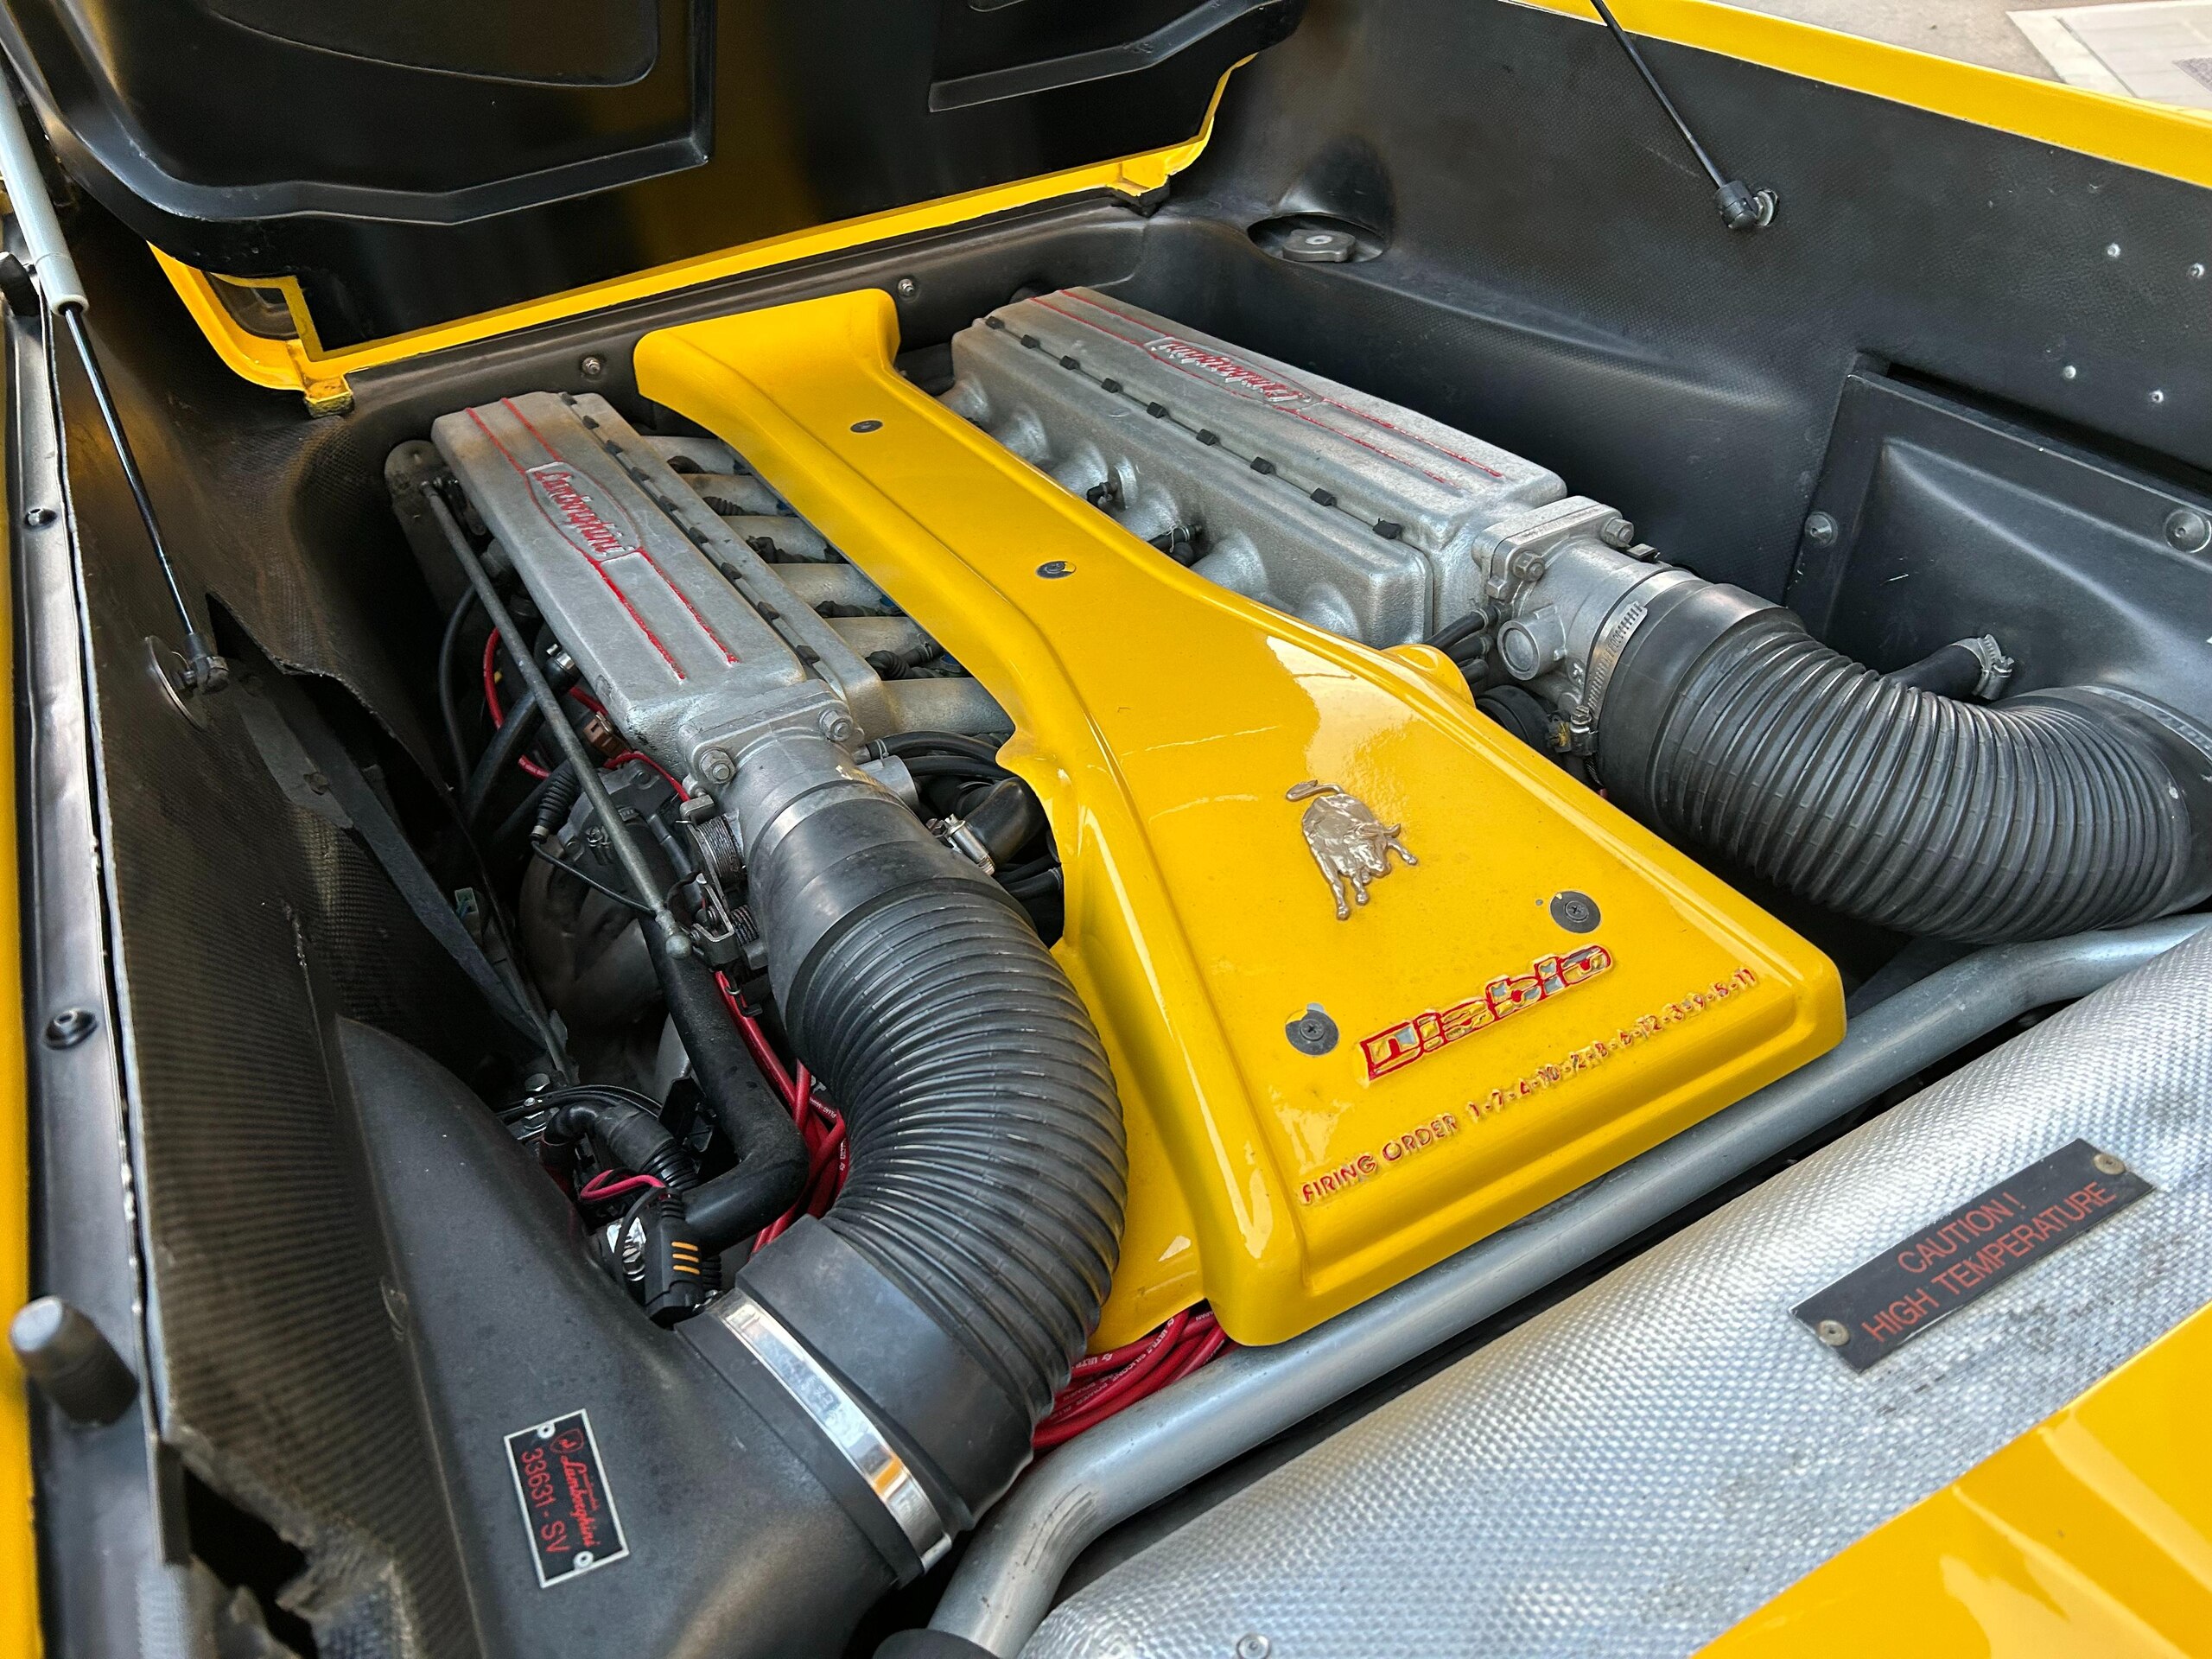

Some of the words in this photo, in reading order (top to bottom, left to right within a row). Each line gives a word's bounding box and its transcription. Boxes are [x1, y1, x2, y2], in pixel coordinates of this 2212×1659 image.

[532, 471, 634, 556] Lamborghini
[1359, 944, 1612, 1081] Diablo
[1301, 1154, 1377, 1203] FIRING
[1382, 1113, 1458, 1163] ORDER
[1861, 1288, 1940, 1342] HIGH
[1931, 1181, 2117, 1294] TEMPERATURE
[522, 1447, 556, 1508] 33631
[541, 1521, 571, 1553] SV
[560, 1455, 601, 1548] Lamborghini
